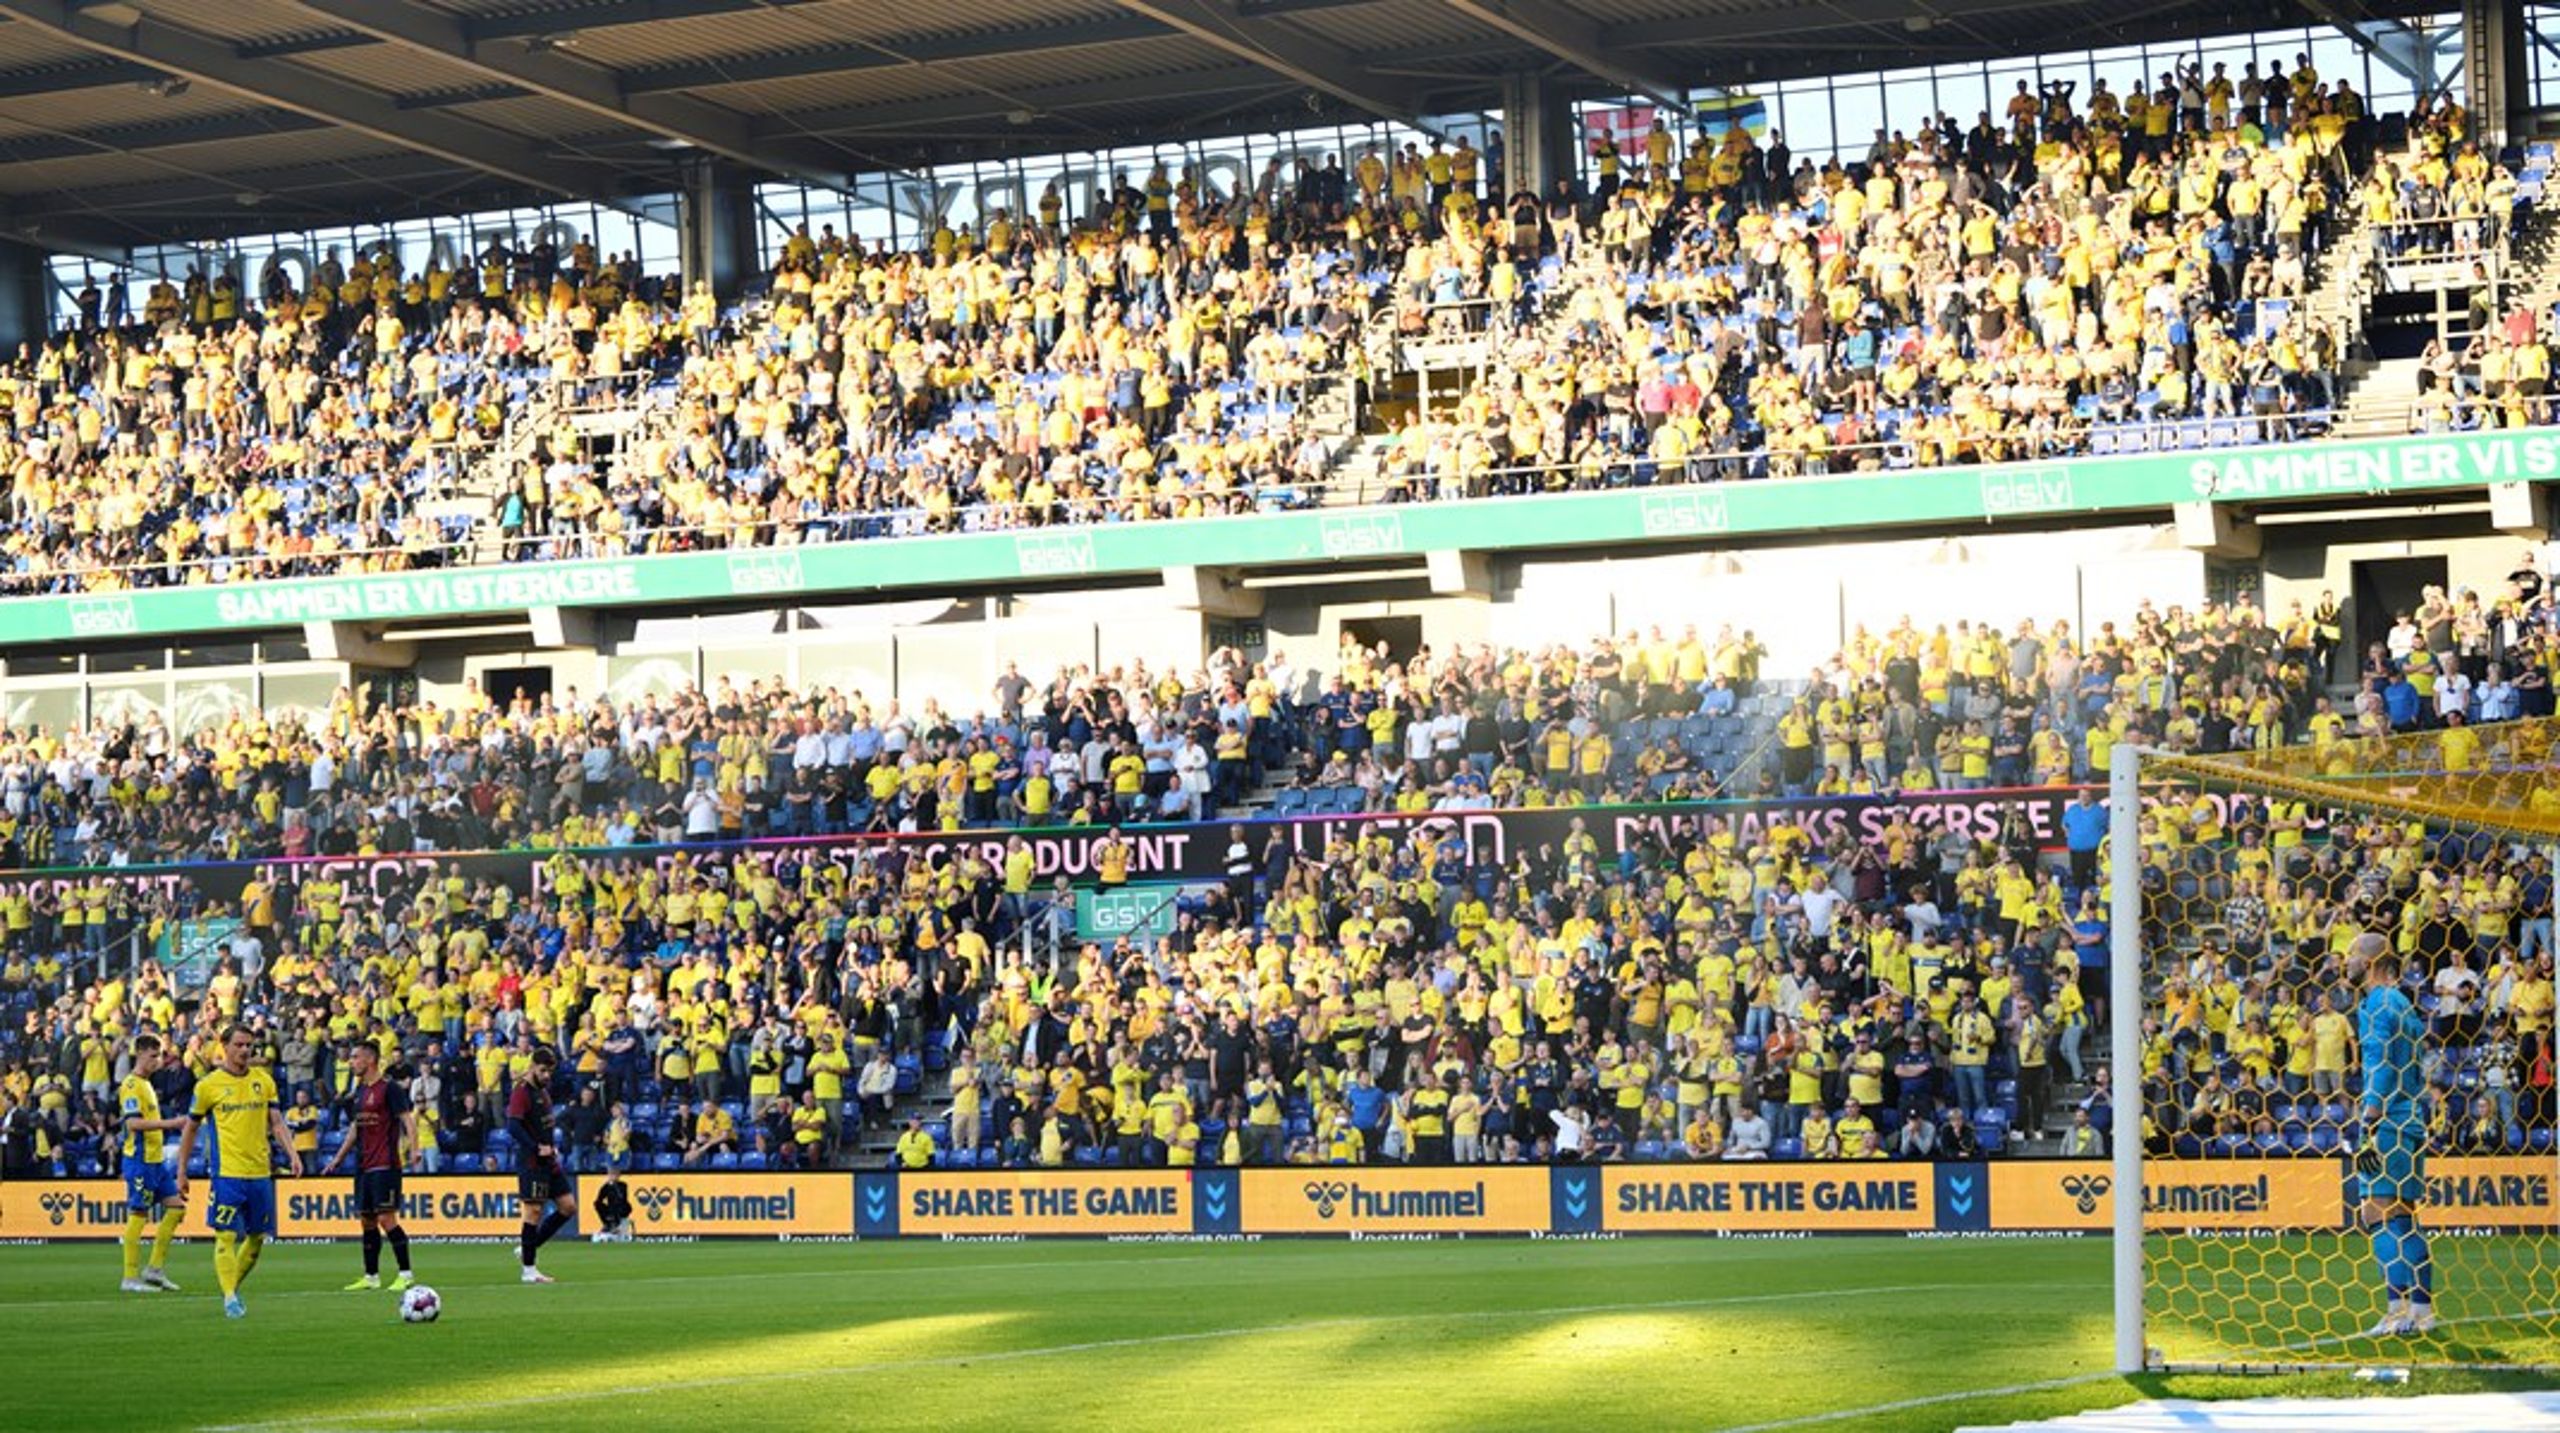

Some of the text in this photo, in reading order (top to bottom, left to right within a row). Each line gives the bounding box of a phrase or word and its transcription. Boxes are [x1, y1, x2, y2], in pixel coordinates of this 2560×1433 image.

[2189, 436, 2560, 496] SAMMEN ER VI S
[1986, 480, 2066, 508] GSV
[1647, 504, 1725, 530] GSV
[1326, 526, 1396, 552] GSV
[1022, 547, 1090, 572] GSV
[733, 566, 800, 590] GSV
[217, 564, 641, 623] SAMMEN ER VI STÆRKERE
[74, 611, 136, 633] GSV
[1097, 905, 1158, 927] GSV
[677, 1186, 796, 1221] hummel
[913, 1186, 1178, 1217] SHARE THE GAME
[1351, 1180, 1485, 1218] hummel
[1618, 1180, 1918, 1212] SHARE THE GAME
[2141, 1174, 2269, 1213] ummel
[2425, 1174, 2548, 1207] SHARE
[216, 1205, 235, 1226] 27
[289, 1192, 522, 1221] SHAR HE GAME
